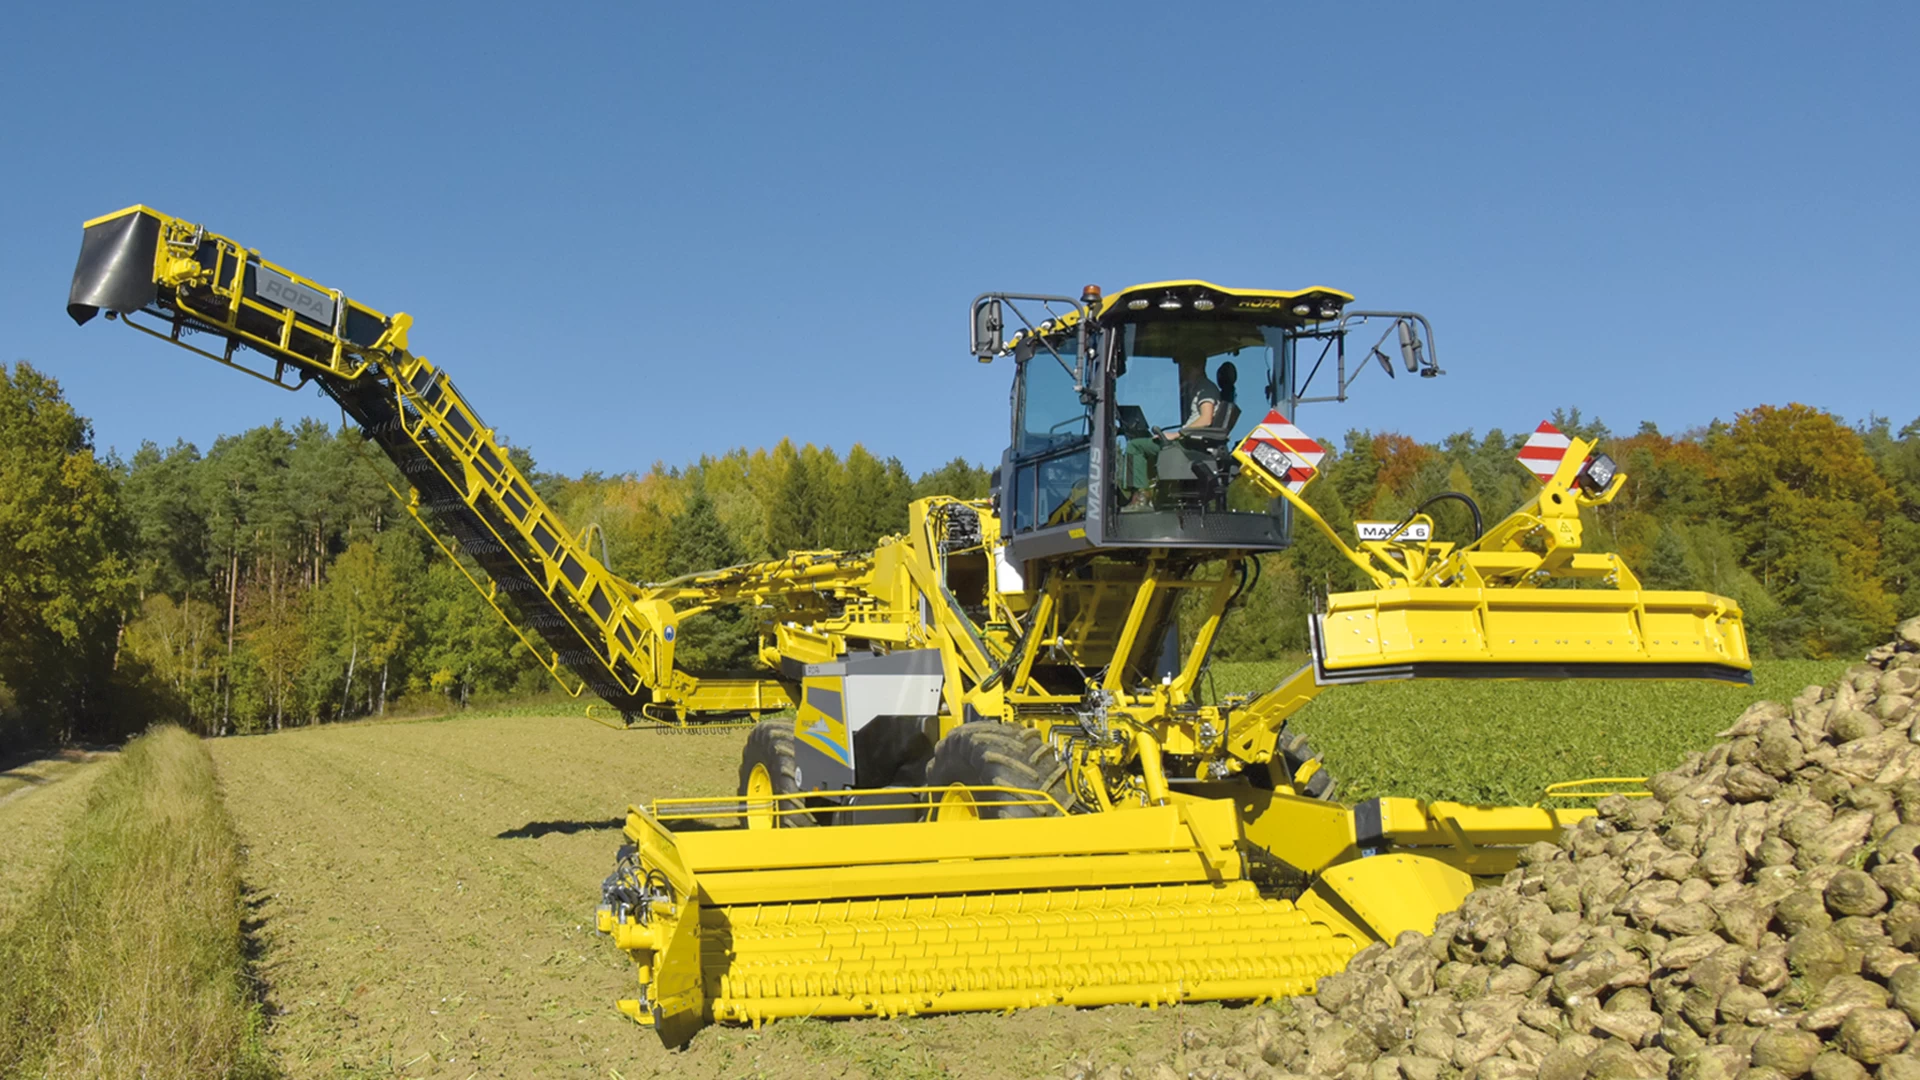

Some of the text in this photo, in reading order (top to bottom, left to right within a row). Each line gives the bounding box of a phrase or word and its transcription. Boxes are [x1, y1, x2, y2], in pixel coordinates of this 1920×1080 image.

[265, 279, 325, 316] ROPA
[1088, 447, 1100, 520] MAUS
[1415, 528, 1425, 537] 6
